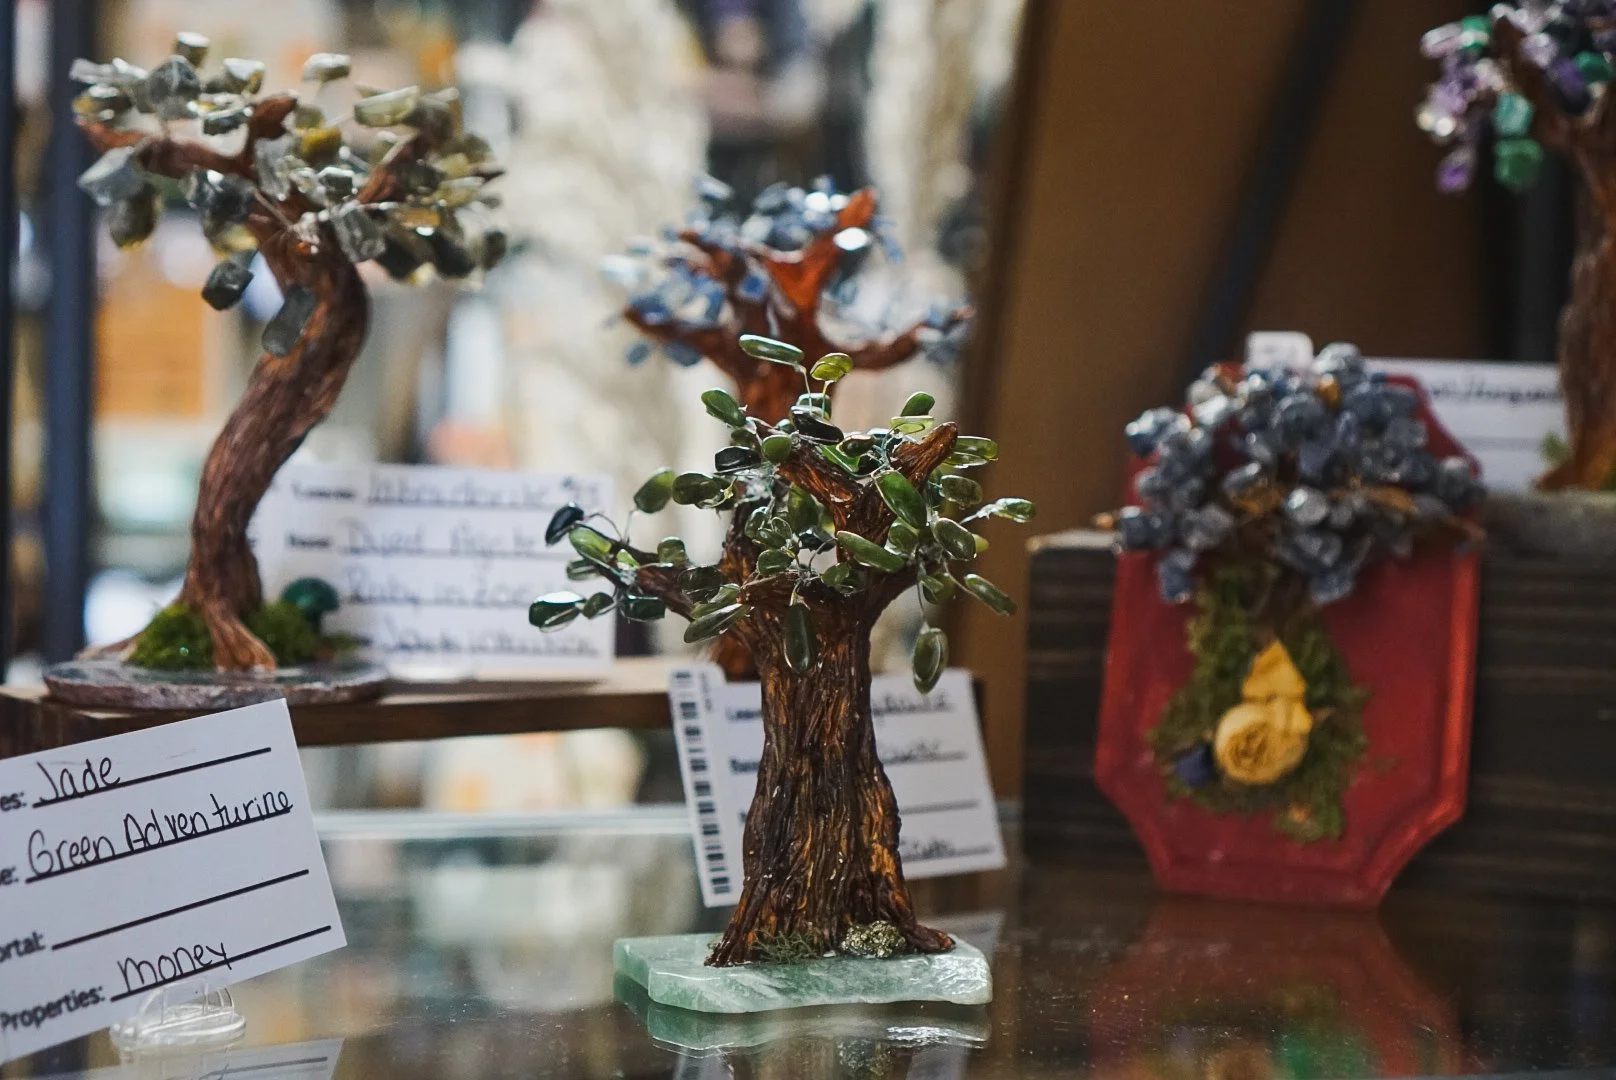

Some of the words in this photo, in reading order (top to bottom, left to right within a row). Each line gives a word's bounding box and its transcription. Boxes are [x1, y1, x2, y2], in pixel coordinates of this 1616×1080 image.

[36, 757, 121, 803] Jade
[28, 829, 116, 878] Green
[123, 790, 294, 852] Adventurine
